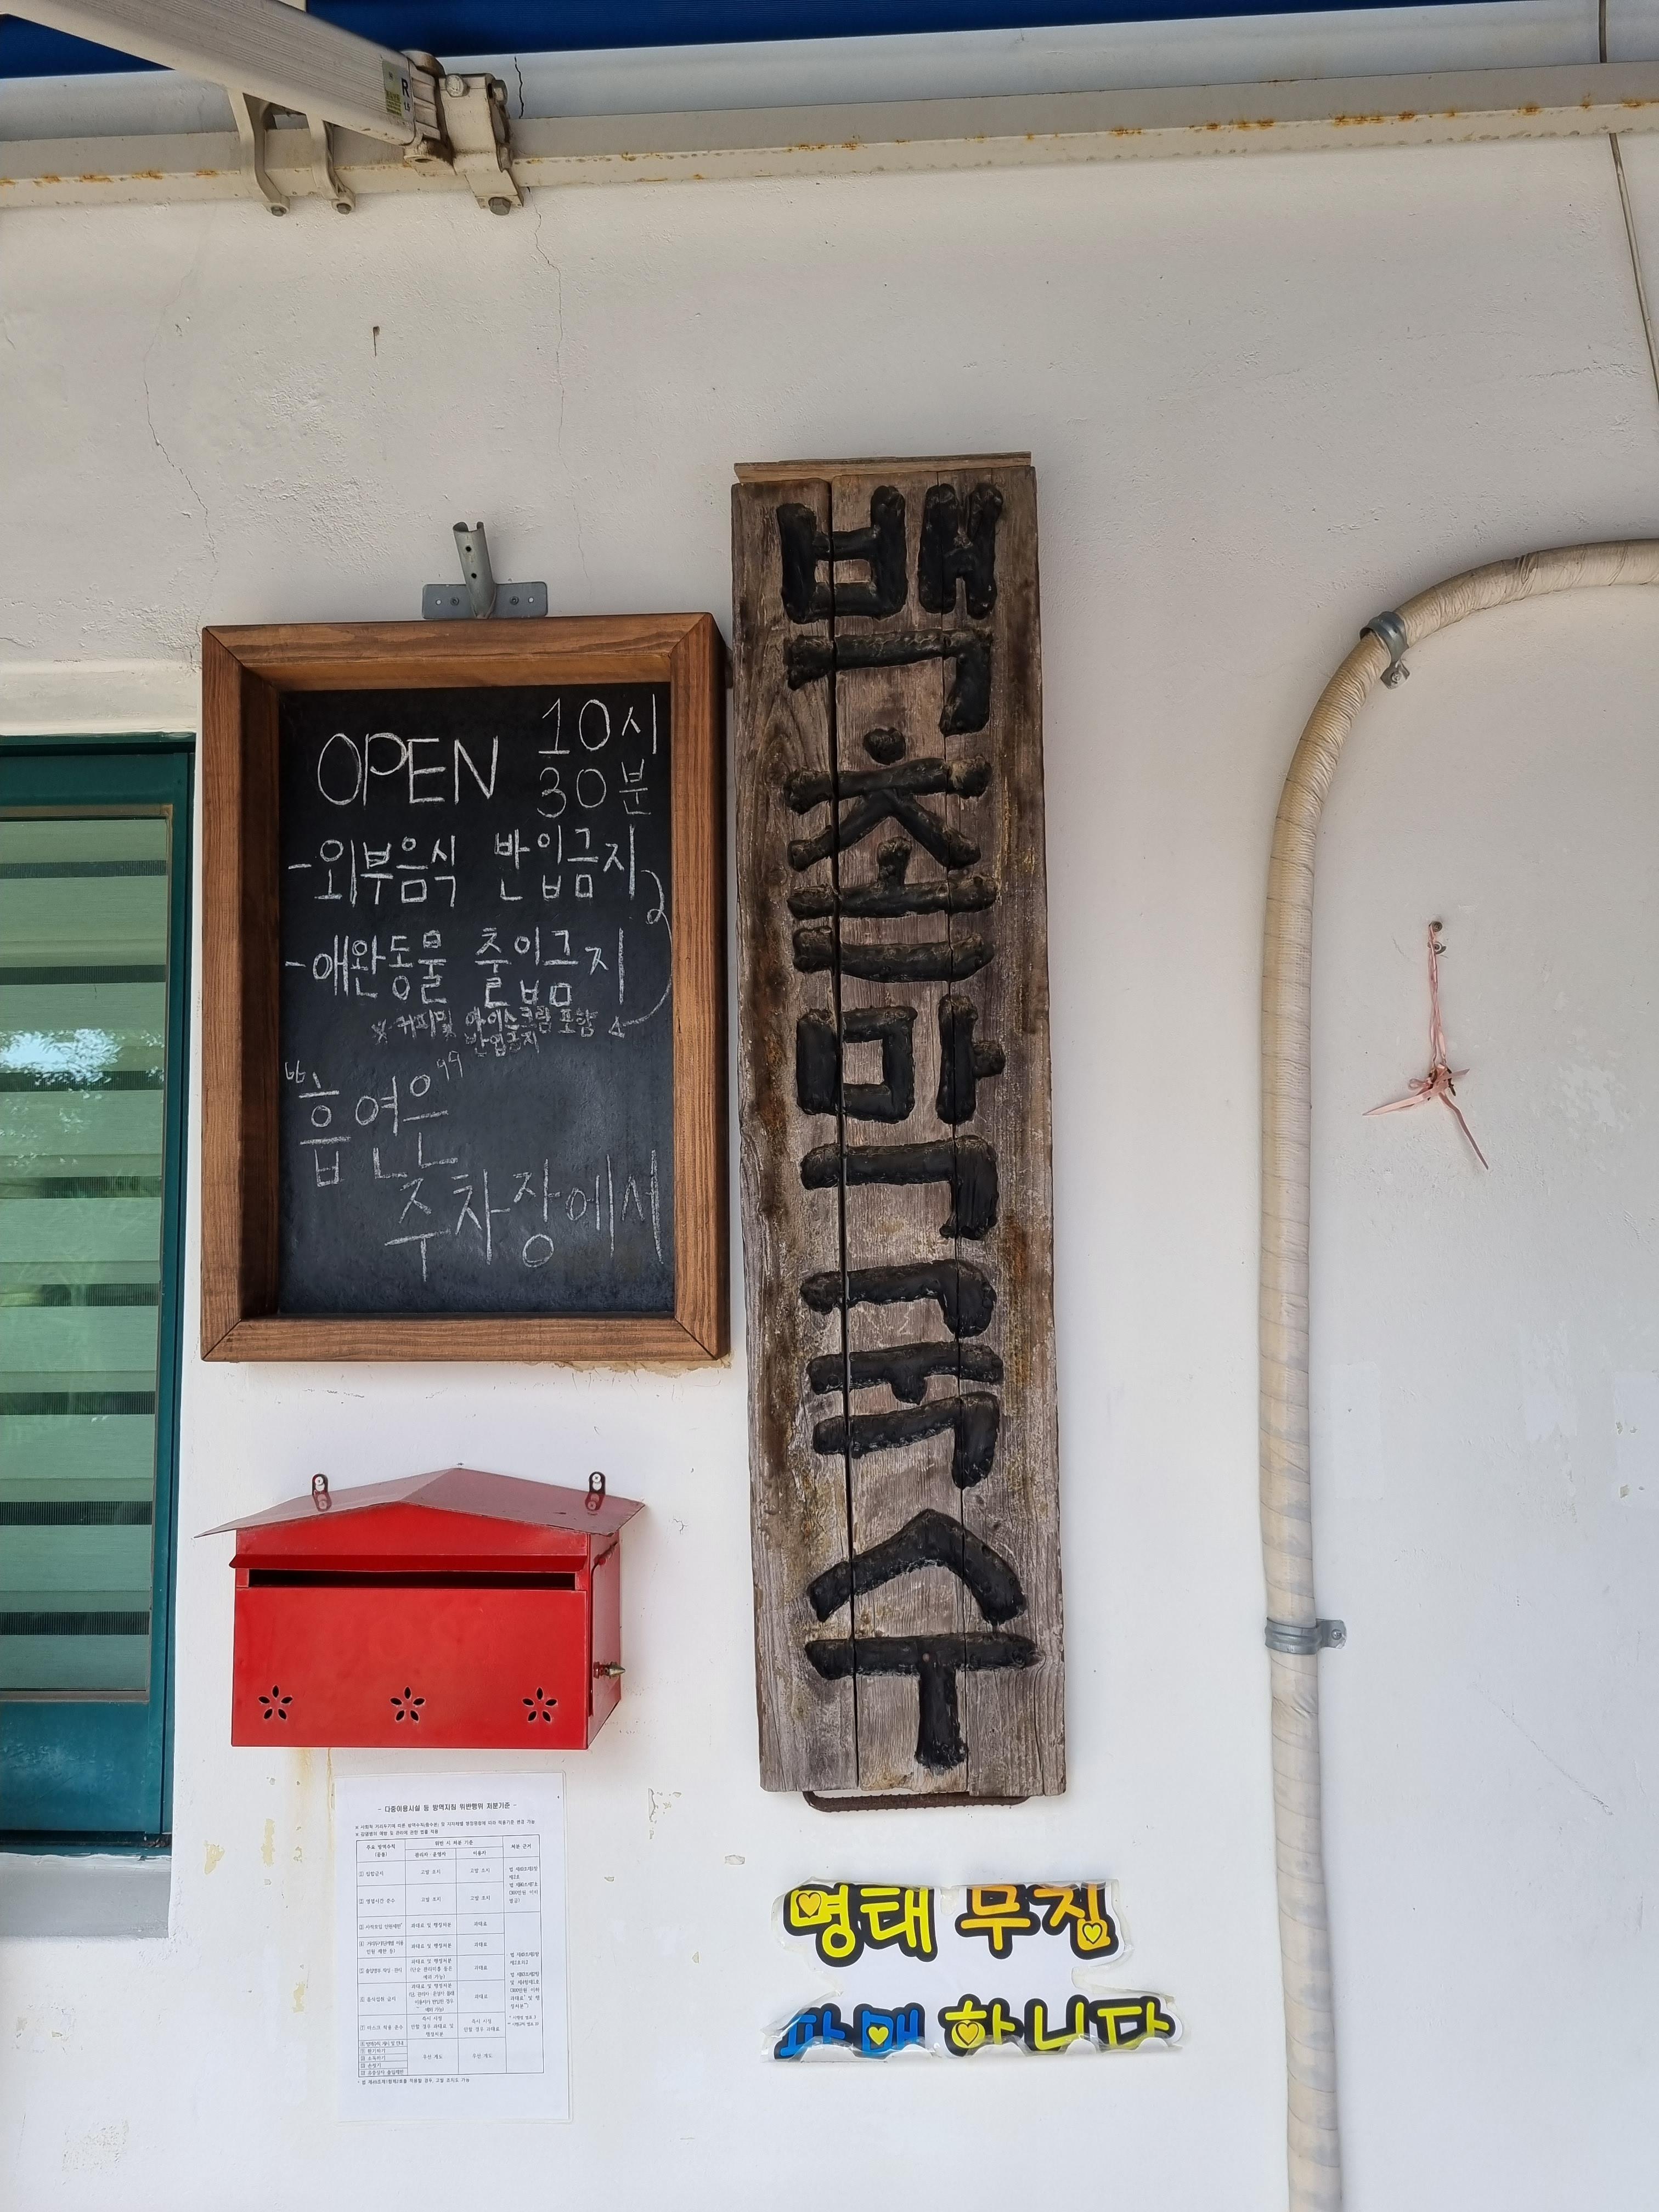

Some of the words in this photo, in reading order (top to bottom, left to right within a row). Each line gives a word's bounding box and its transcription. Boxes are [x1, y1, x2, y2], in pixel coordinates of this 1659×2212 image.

[401, 77, 410, 98] R
[318, 732, 499, 806] OPEN
[538, 693, 657, 755] 10시
[536, 759, 651, 818] 30분
[494, 824, 636, 901] 반입금지
[475, 926, 624, 1008] 출입금지
[557, 1007, 599, 1038] 포함
[384, 1150, 664, 1282] 주차장에서
[785, 1883, 936, 1966] 명태
